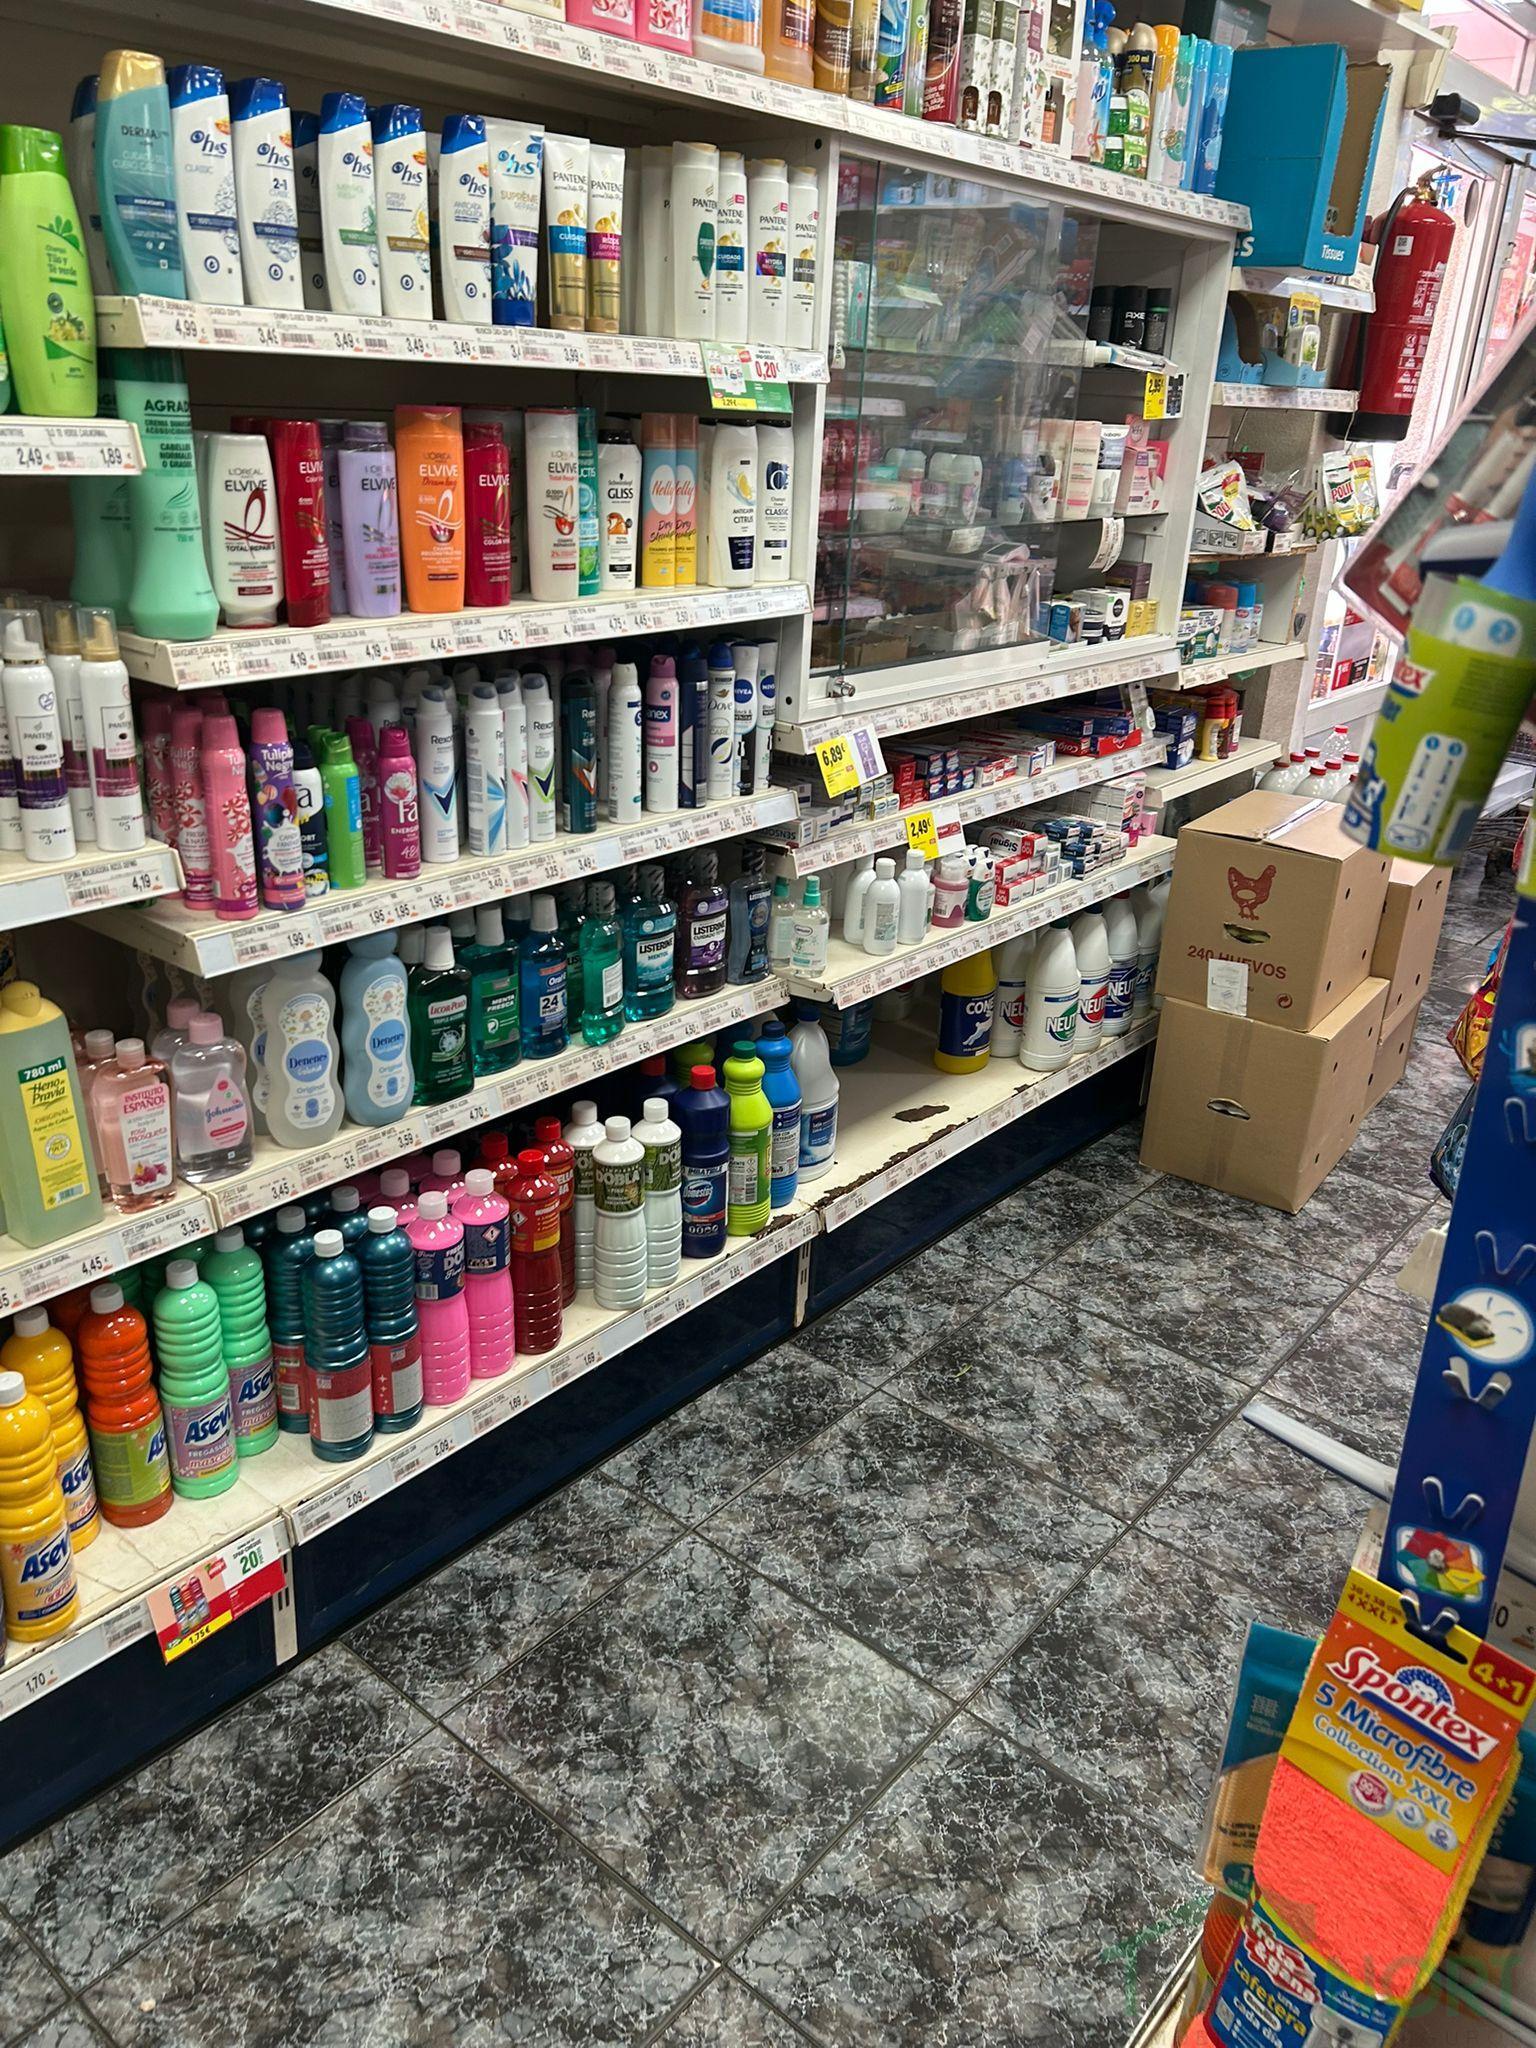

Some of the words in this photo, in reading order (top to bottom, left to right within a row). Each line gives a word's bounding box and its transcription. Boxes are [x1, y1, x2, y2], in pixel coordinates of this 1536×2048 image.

[553, 172, 588, 185] PANTENE
[717, 208, 744, 218] ANTENE
[1320, 244, 1346, 262] Tissues
[1125, 311, 1145, 320] AXE
[175, 319, 198, 338] 4,99
[17, 447, 44, 468] 2,49
[419, 464, 459, 478] ELVIVE
[548, 462, 578, 473] ELVIVE
[224, 479, 269, 493] ELVIVE
[361, 478, 396, 491] ELVIVE
[479, 474, 510, 487] ELVIVE
[607, 487, 634, 499] GLISS
[708, 701, 733, 711] Dove
[398, 800, 419, 824] Fa
[301, 833, 316, 841] ORT
[910, 819, 932, 838] 2,49€
[132, 874, 151, 891] 4,19
[693, 921, 726, 936] LISTERINE
[639, 939, 674, 955] LISTERINE
[1187, 945, 1214, 961] 240
[1108, 978, 1136, 997] NEUT
[541, 996, 558, 1010] 24
[1077, 996, 1105, 1015] NEUT
[1045, 1012, 1077, 1034] NEUT
[372, 1032, 405, 1047] Denenes
[289, 1053, 328, 1068] Denenes
[23, 1066, 45, 1080] 780
[47, 1060, 62, 1072] ml
[124, 1087, 164, 1103] INSTITUTO
[124, 1096, 168, 1115] ESPAÑOL
[595, 1170, 640, 1186] DOBLA
[271, 1183, 290, 1199] 3,45
[181, 1218, 201, 1236] 3,39
[82, 1256, 104, 1276] 4,45
[238, 1367, 274, 1404] Asev
[21, 1534, 69, 1584] Asev
[240, 1551, 259, 1577] 20
[25, 1672, 46, 1694] 1,70
[1473, 1662, 1526, 1702] 4+1
[1326, 1647, 1493, 1757] Spontex
[1314, 1681, 1336, 1707] 5
[1340, 1699, 1476, 1800] Microfibre
[1313, 1713, 1405, 1787] Collection
[1410, 1777, 1454, 1820] XXL
[1234, 1958, 1307, 2038] cafetera
[1276, 1991, 1301, 2017] una
[1233, 1996, 1260, 2029] cada
